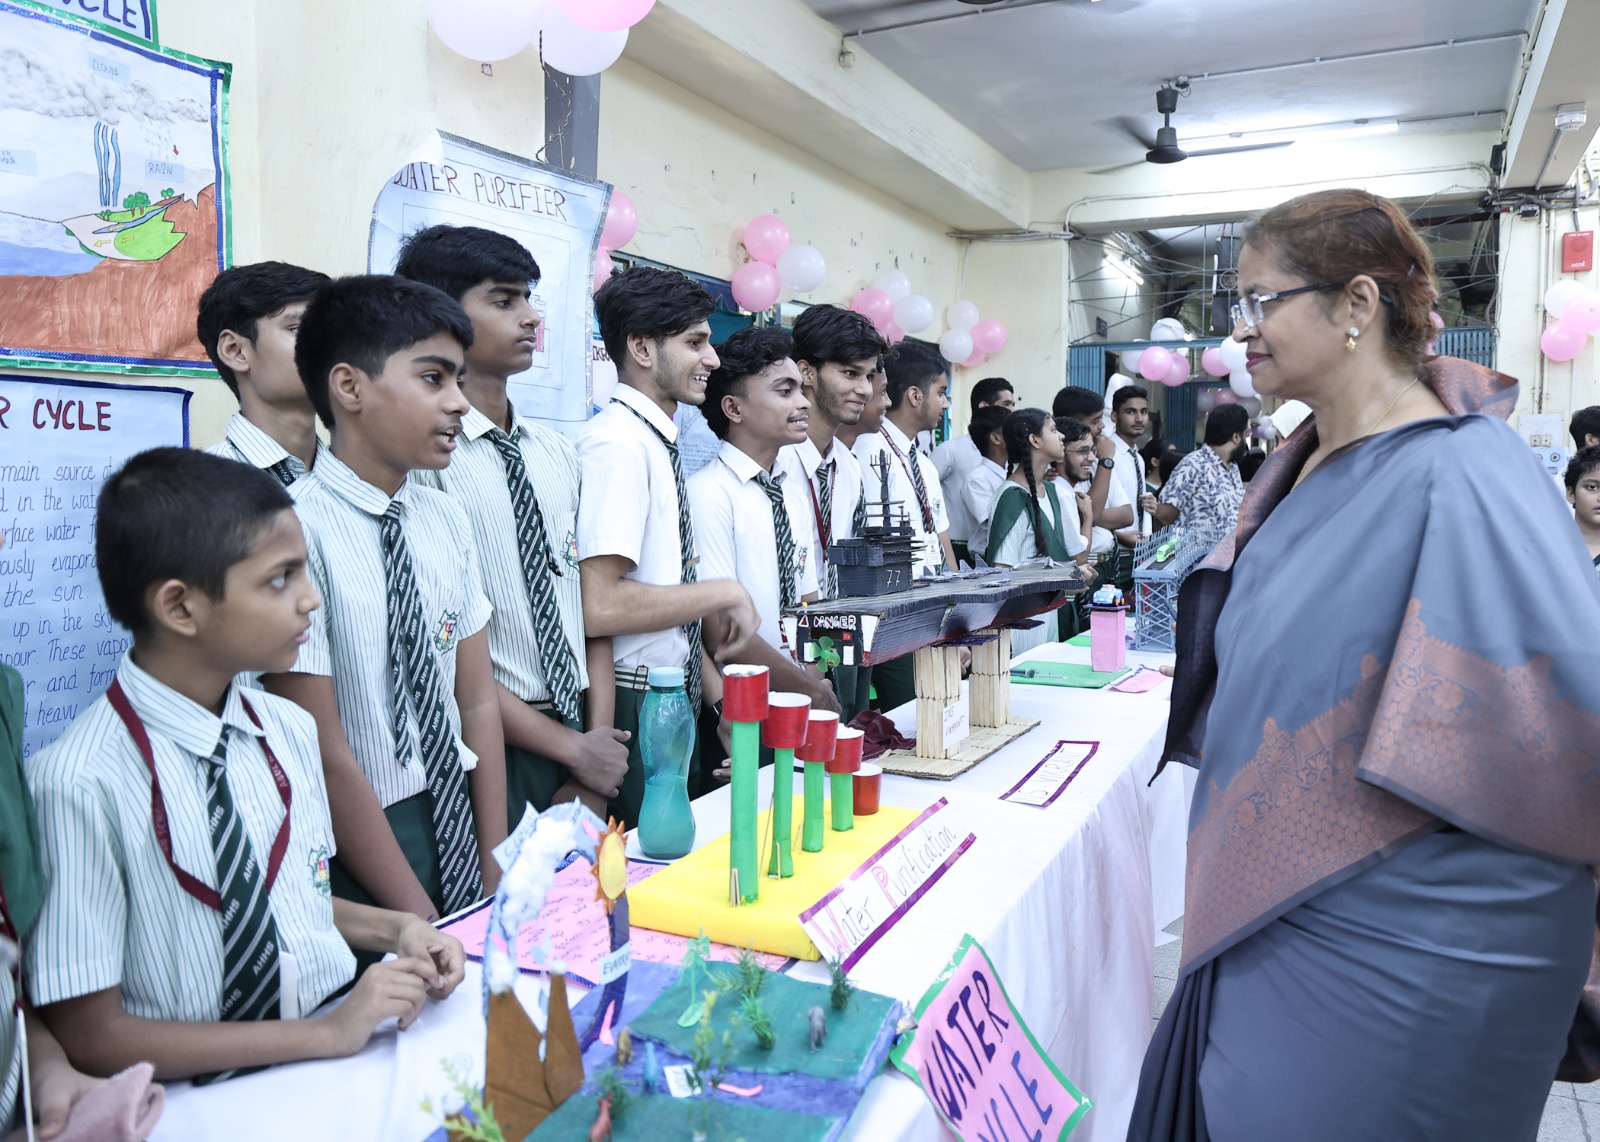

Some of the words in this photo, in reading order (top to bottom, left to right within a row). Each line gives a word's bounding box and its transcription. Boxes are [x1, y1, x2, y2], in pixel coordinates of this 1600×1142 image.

[474, 172, 567, 221] PURIFIER
[33, 399, 111, 431] CYCLE
[1, 461, 40, 482] main
[53, 468, 96, 481] source
[18, 491, 34, 512] in
[43, 487, 63, 511] the
[46, 516, 81, 542] water
[886, 569, 901, 587] 77
[4, 580, 36, 608] the
[13, 621, 30, 643] up
[38, 616, 53, 635] in
[63, 608, 83, 632] the
[93, 604, 113, 633] sky
[813, 614, 857, 632] DANGER
[47, 638, 86, 662] These
[46, 668, 79, 693] and
[431, 776, 444, 798] AHHS
[443, 819, 455, 840] AHHS
[452, 857, 465, 877] AHHS
[807, 888, 877, 963] Water
[871, 824, 957, 910] Purification
[252, 940, 275, 976] AHHS
[925, 970, 1009, 1131] WATER
